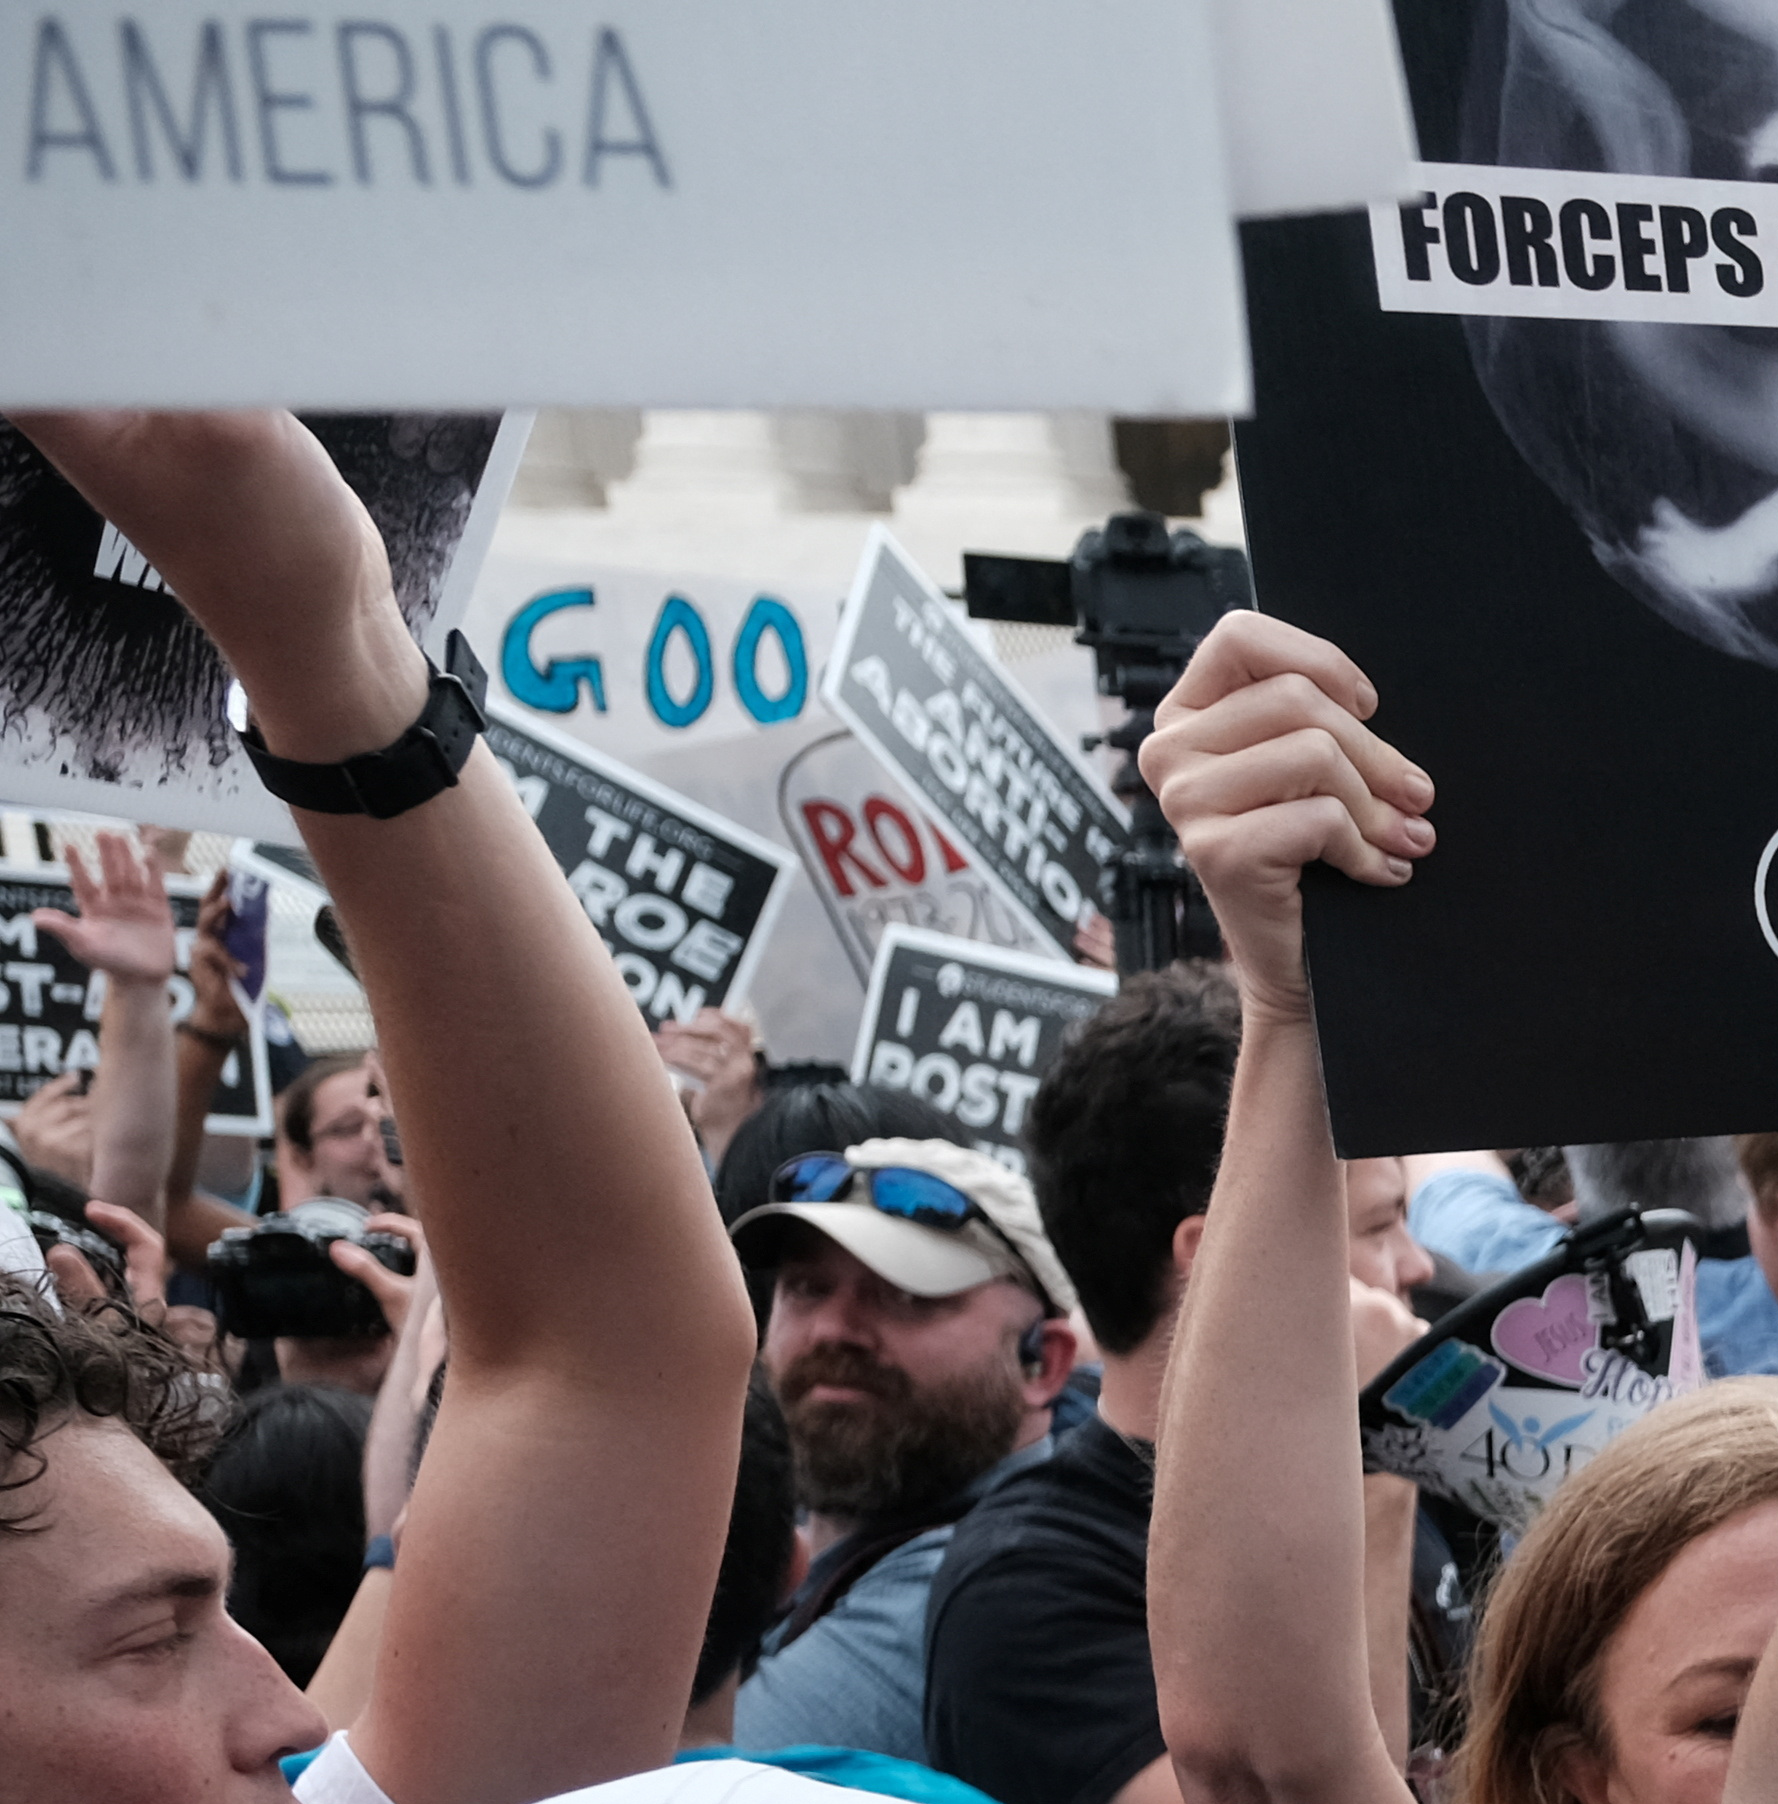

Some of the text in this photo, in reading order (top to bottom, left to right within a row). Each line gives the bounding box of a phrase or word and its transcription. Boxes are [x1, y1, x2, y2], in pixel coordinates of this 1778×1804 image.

[24, 14, 675, 190] AMERICA
[1401, 191, 1765, 298] FORCEPS
[585, 804, 736, 921] THE
[896, 986, 921, 1039] I
[938, 1000, 1042, 1068] AM
[869, 1041, 1042, 1137] POST
